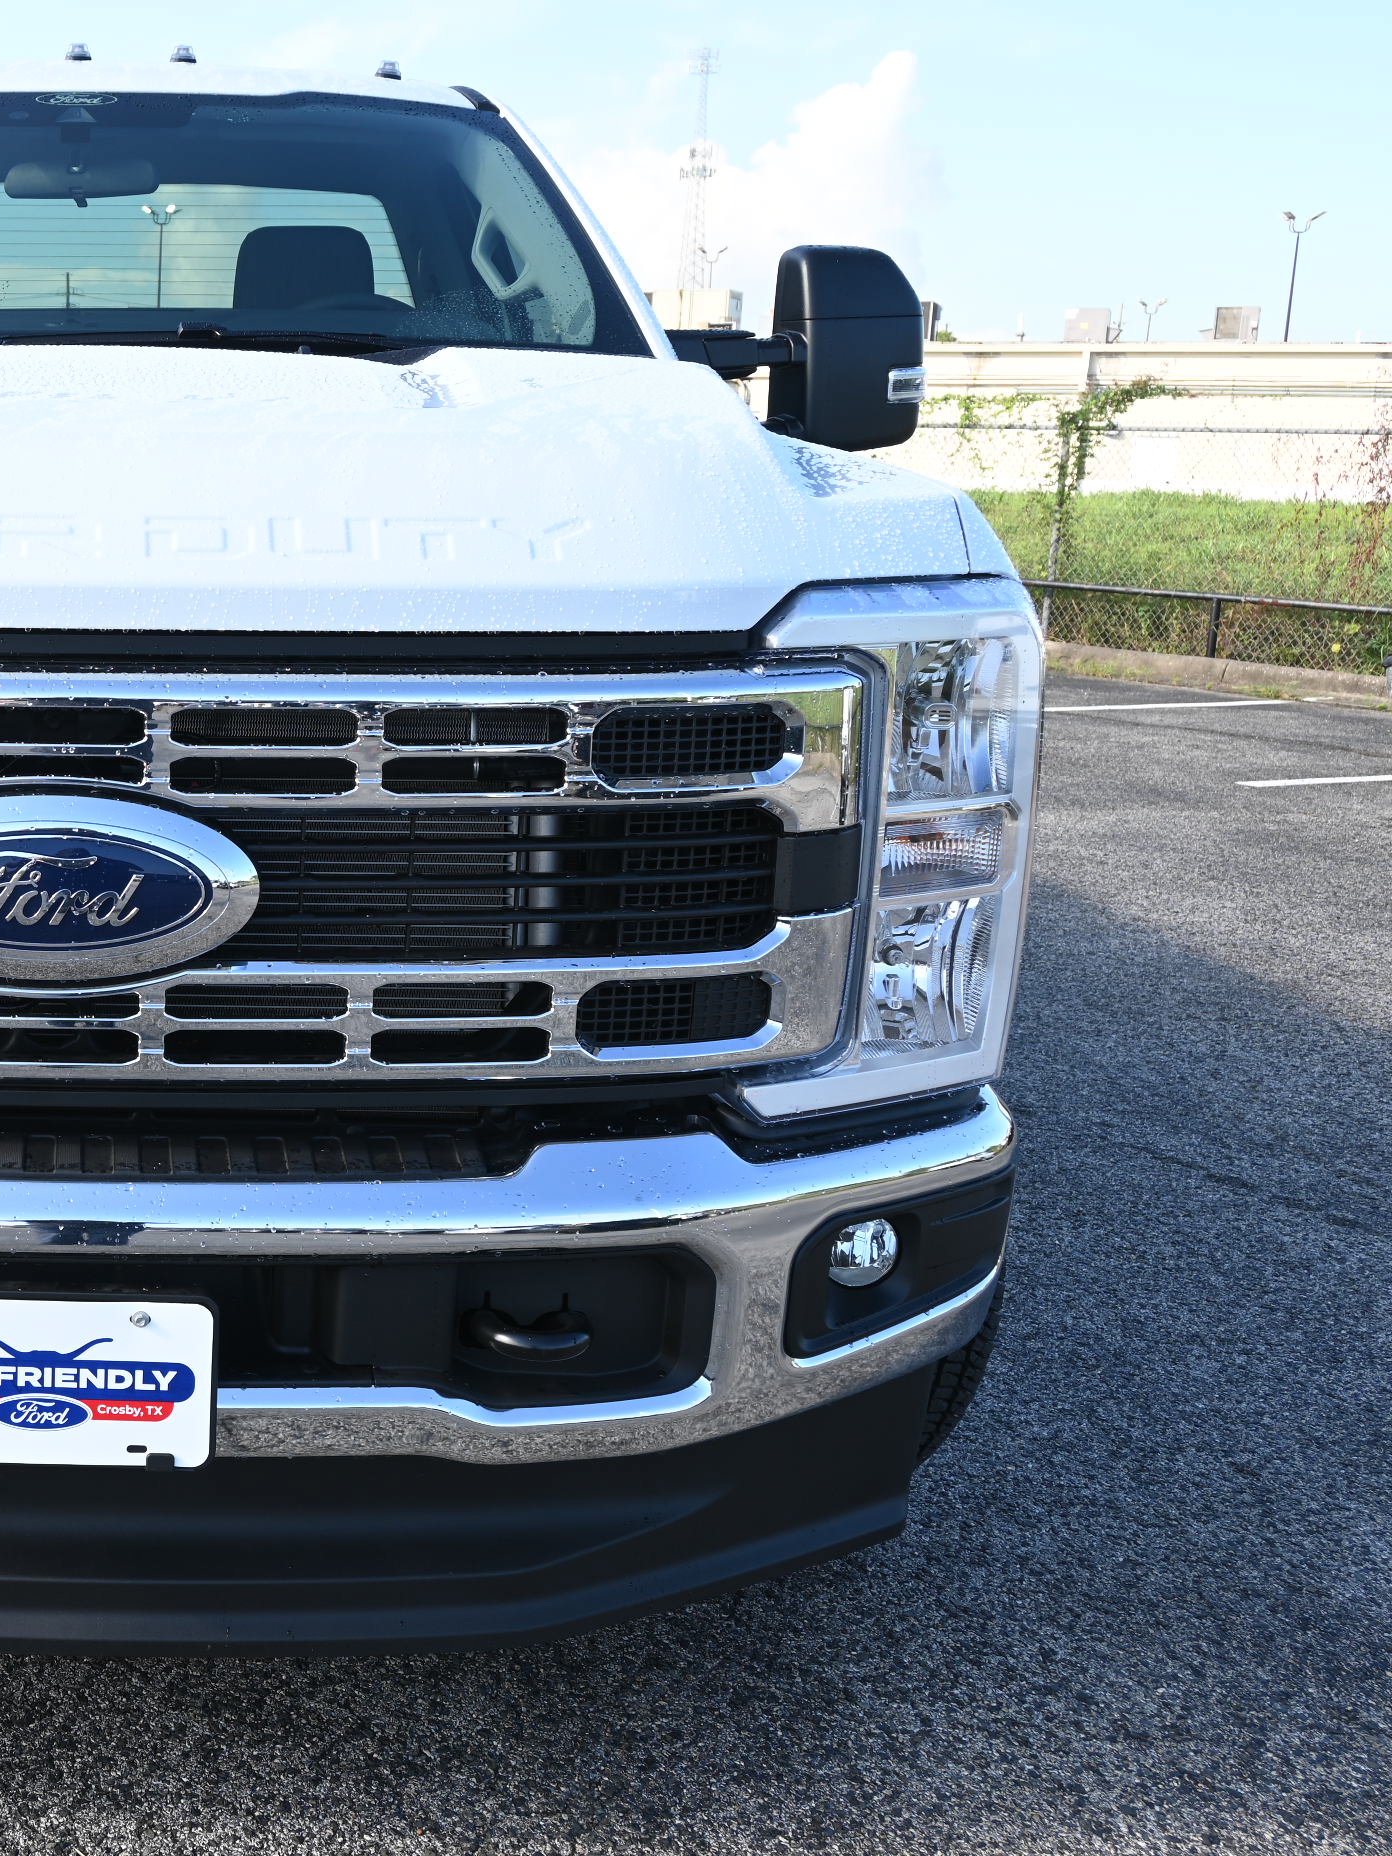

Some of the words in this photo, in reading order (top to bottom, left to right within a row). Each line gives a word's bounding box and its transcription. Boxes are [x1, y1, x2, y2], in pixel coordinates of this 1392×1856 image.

[49, 94, 103, 104] Ford
[143, 517, 593, 561] DUTY
[10, 1400, 70, 1425] Ford
[97, 1404, 144, 1417] Crosby,
[145, 1405, 163, 1416] TX
